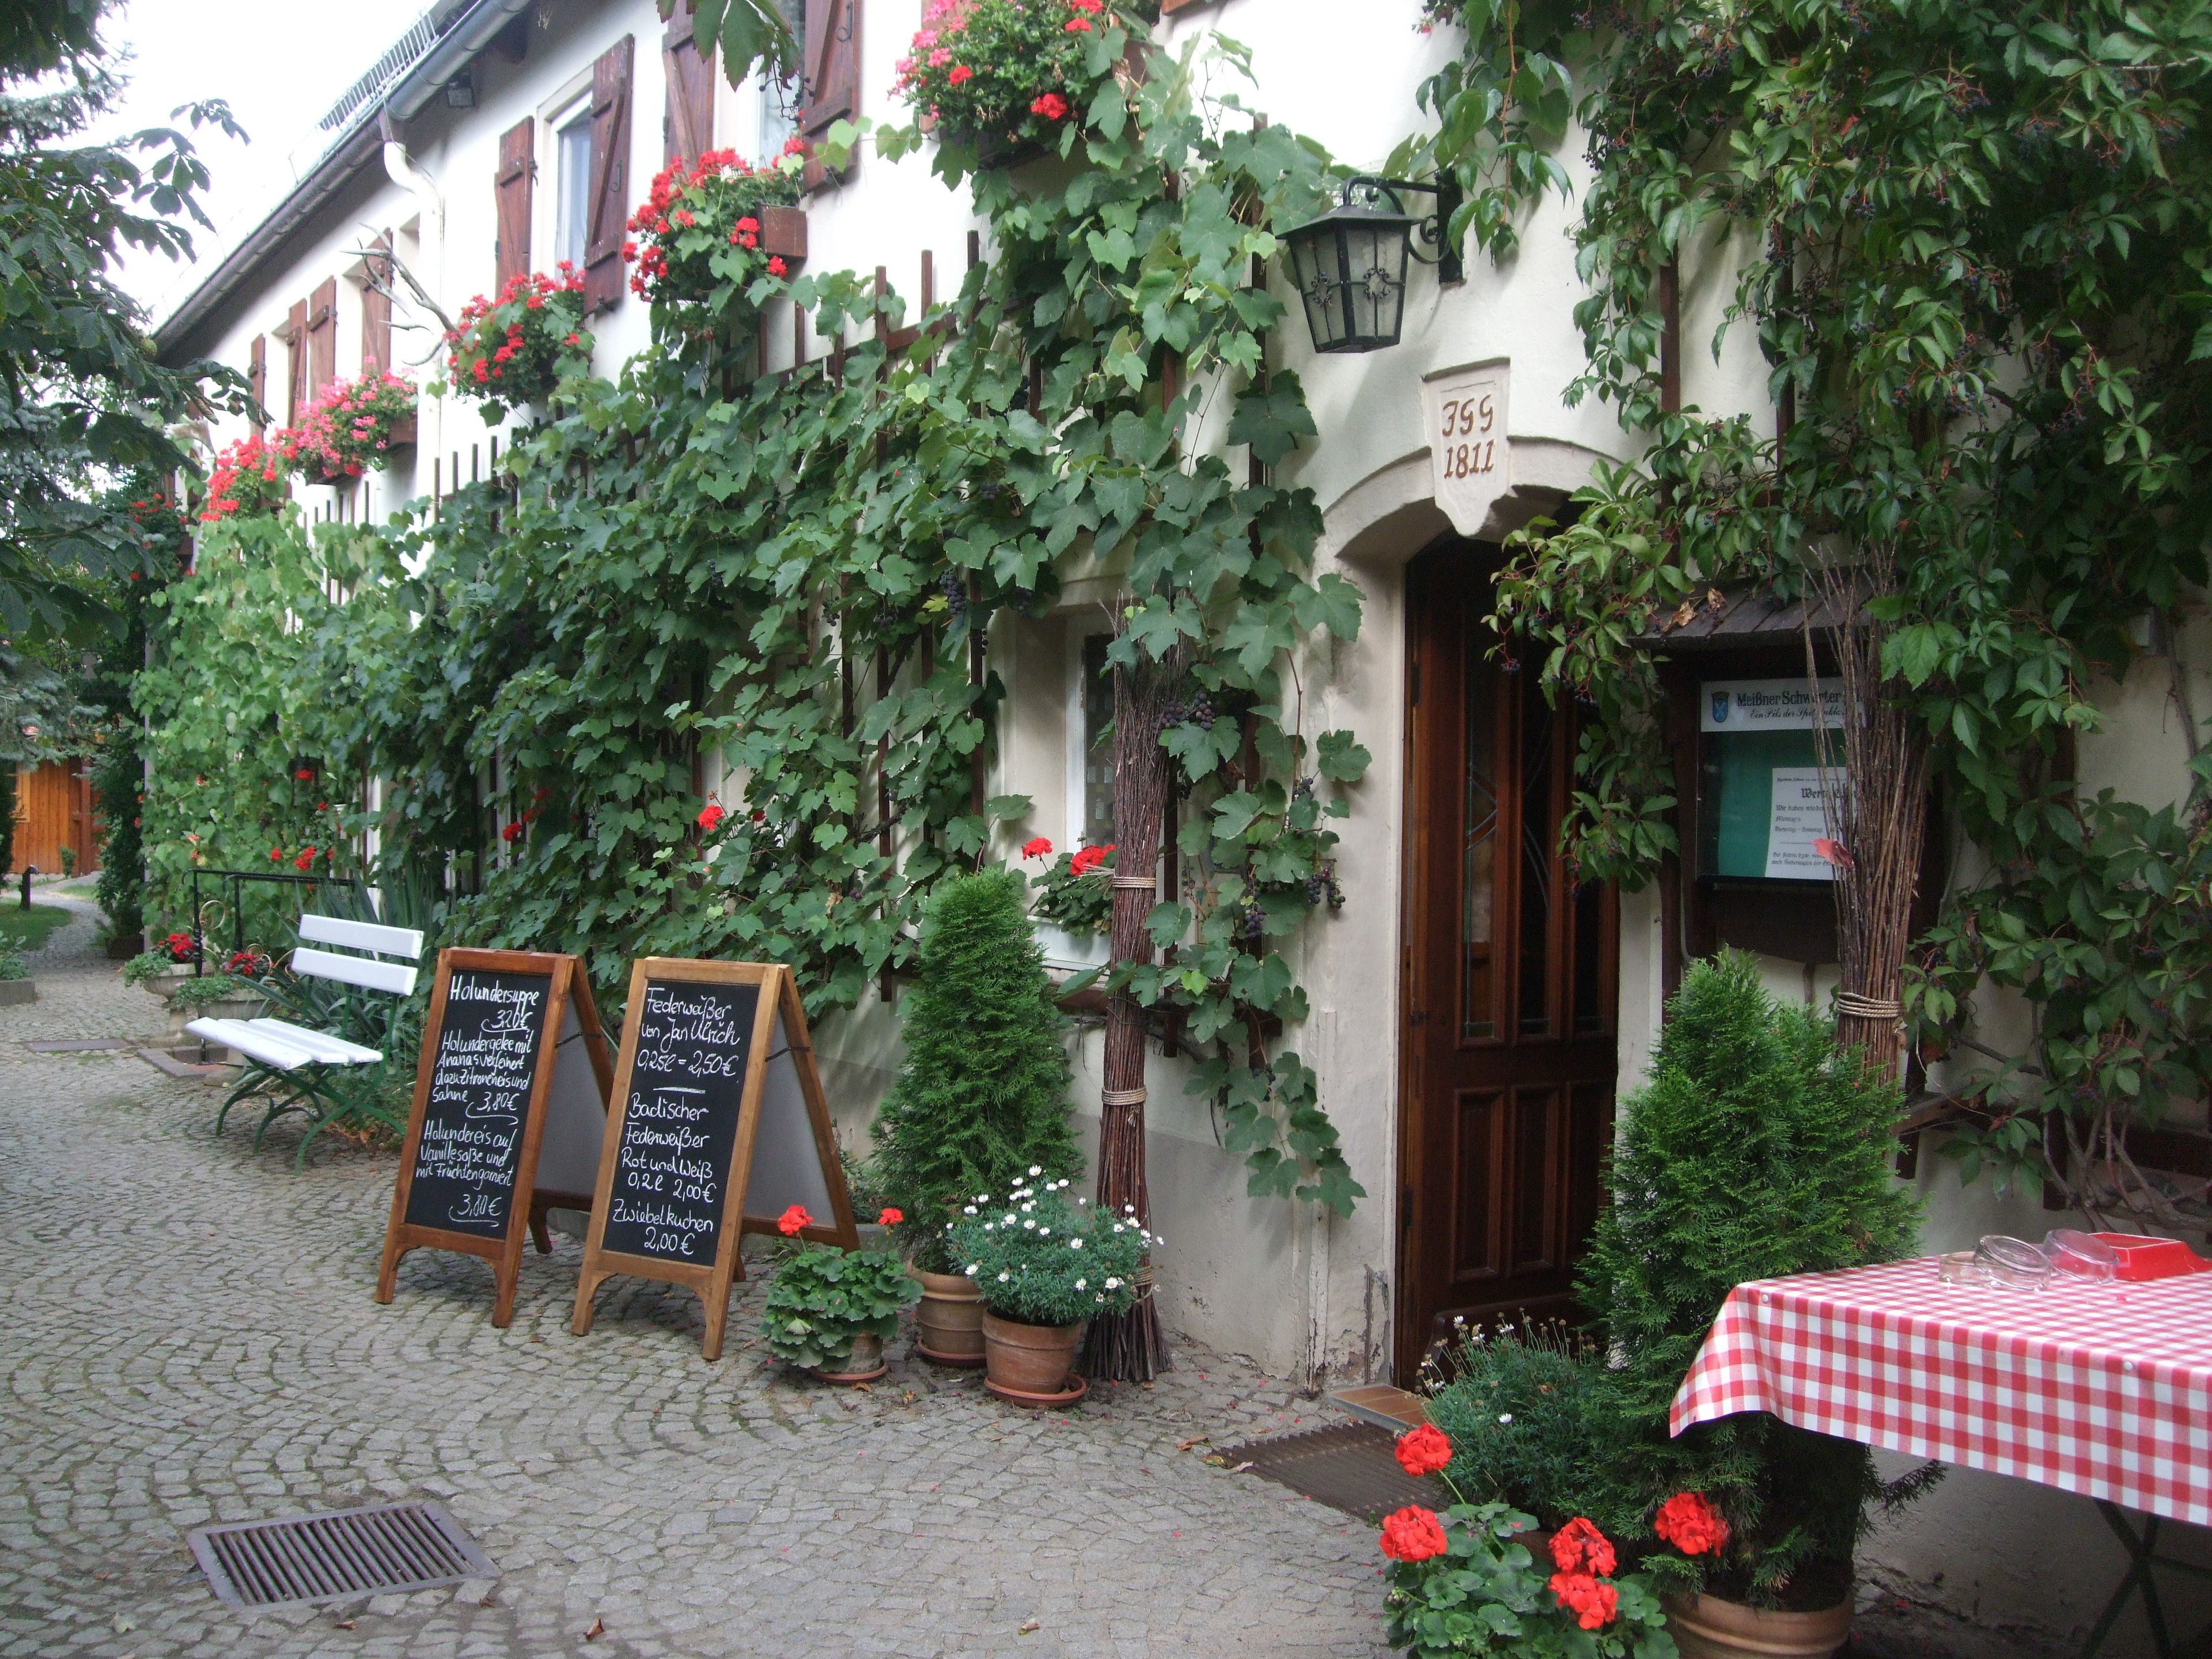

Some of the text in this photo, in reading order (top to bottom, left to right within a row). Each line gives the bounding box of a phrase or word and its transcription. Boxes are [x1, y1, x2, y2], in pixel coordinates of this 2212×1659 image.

[1444, 438, 1494, 479] 1811
[1737, 691, 1781, 707] Meißner
[450, 975, 539, 1016] Holundersuppe
[441, 1029, 535, 1056] Holundergelee mit
[641, 1016, 741, 1054] von Jan Ulrich
[436, 1051, 479, 1067] Ananas
[435, 1066, 531, 1091] dazu Zitroneneis und
[432, 1084, 468, 1103] Sahne
[628, 1092, 710, 1121] Badischer
[423, 1118, 518, 1152] Holundereis auf
[626, 1122, 710, 1156] Federweißer
[421, 1140, 507, 1168] Vanillesoße und
[621, 1146, 713, 1185] Rot und Weiß
[415, 1161, 433, 1179] mit
[434, 1160, 478, 1181] Früchten
[612, 1198, 714, 1232] Zwiebelkuchen
